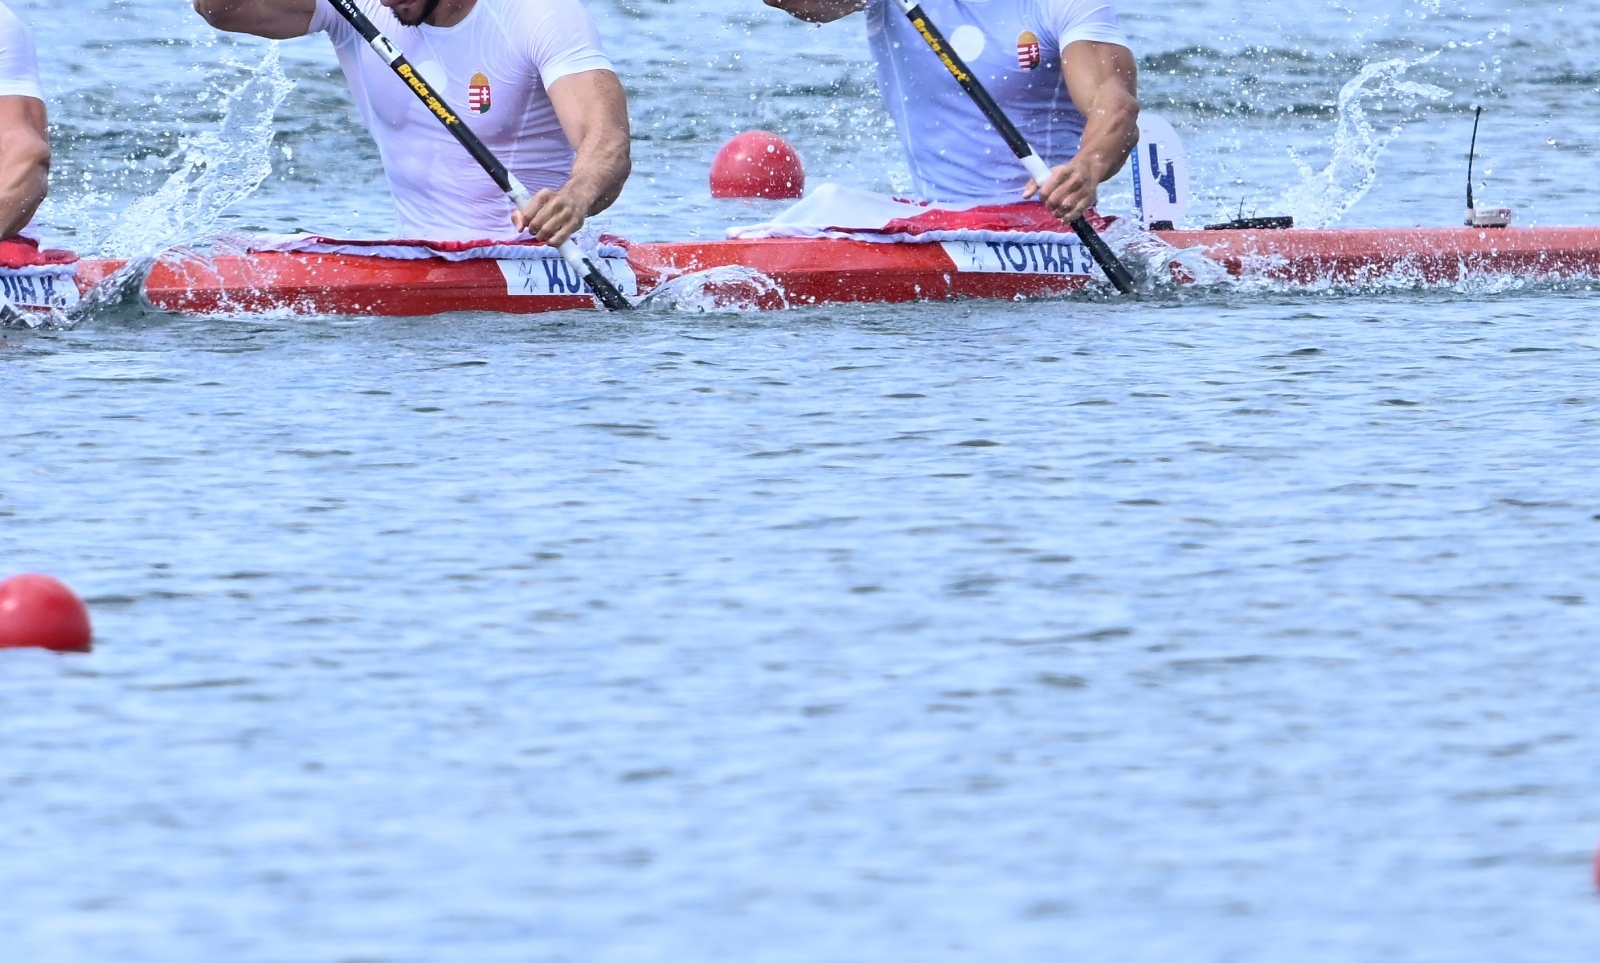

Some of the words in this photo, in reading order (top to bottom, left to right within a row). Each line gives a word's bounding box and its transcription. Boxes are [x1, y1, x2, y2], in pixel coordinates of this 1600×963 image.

[340, 0, 357, 18] 2024
[1149, 143, 1177, 203] 4
[986, 241, 1074, 273] TOTKA
